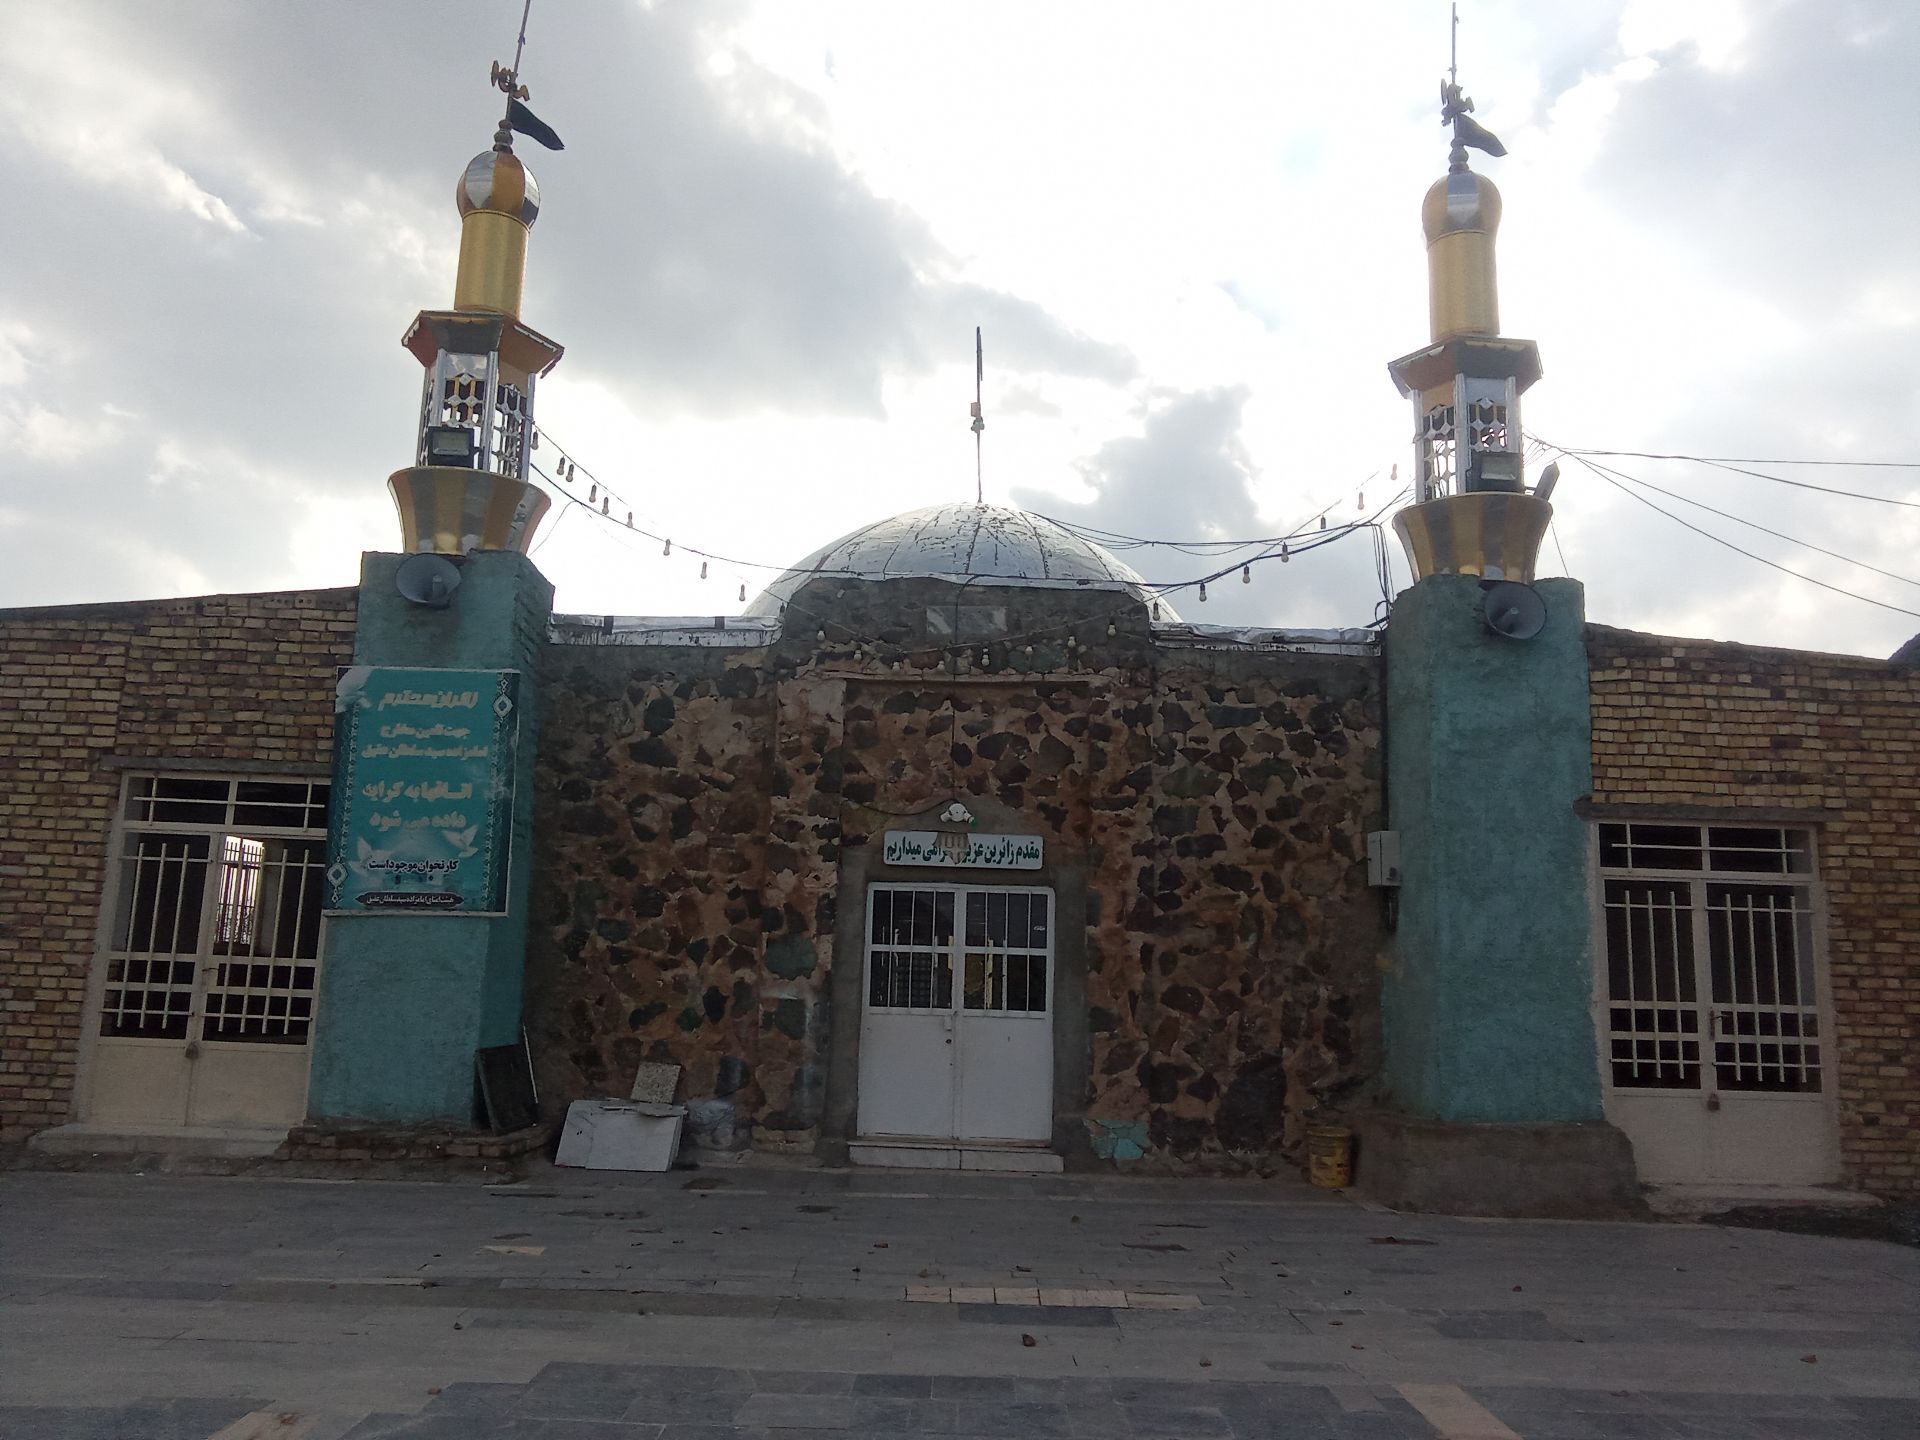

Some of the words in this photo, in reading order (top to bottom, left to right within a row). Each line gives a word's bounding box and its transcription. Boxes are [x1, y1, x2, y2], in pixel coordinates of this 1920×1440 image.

[886, 836, 922, 862] میداریم
[984, 837, 1014, 865] زائرین
[1015, 841, 1040, 864] مقدم
[368, 859, 390, 869] است
[390, 860, 418, 873] موجود
